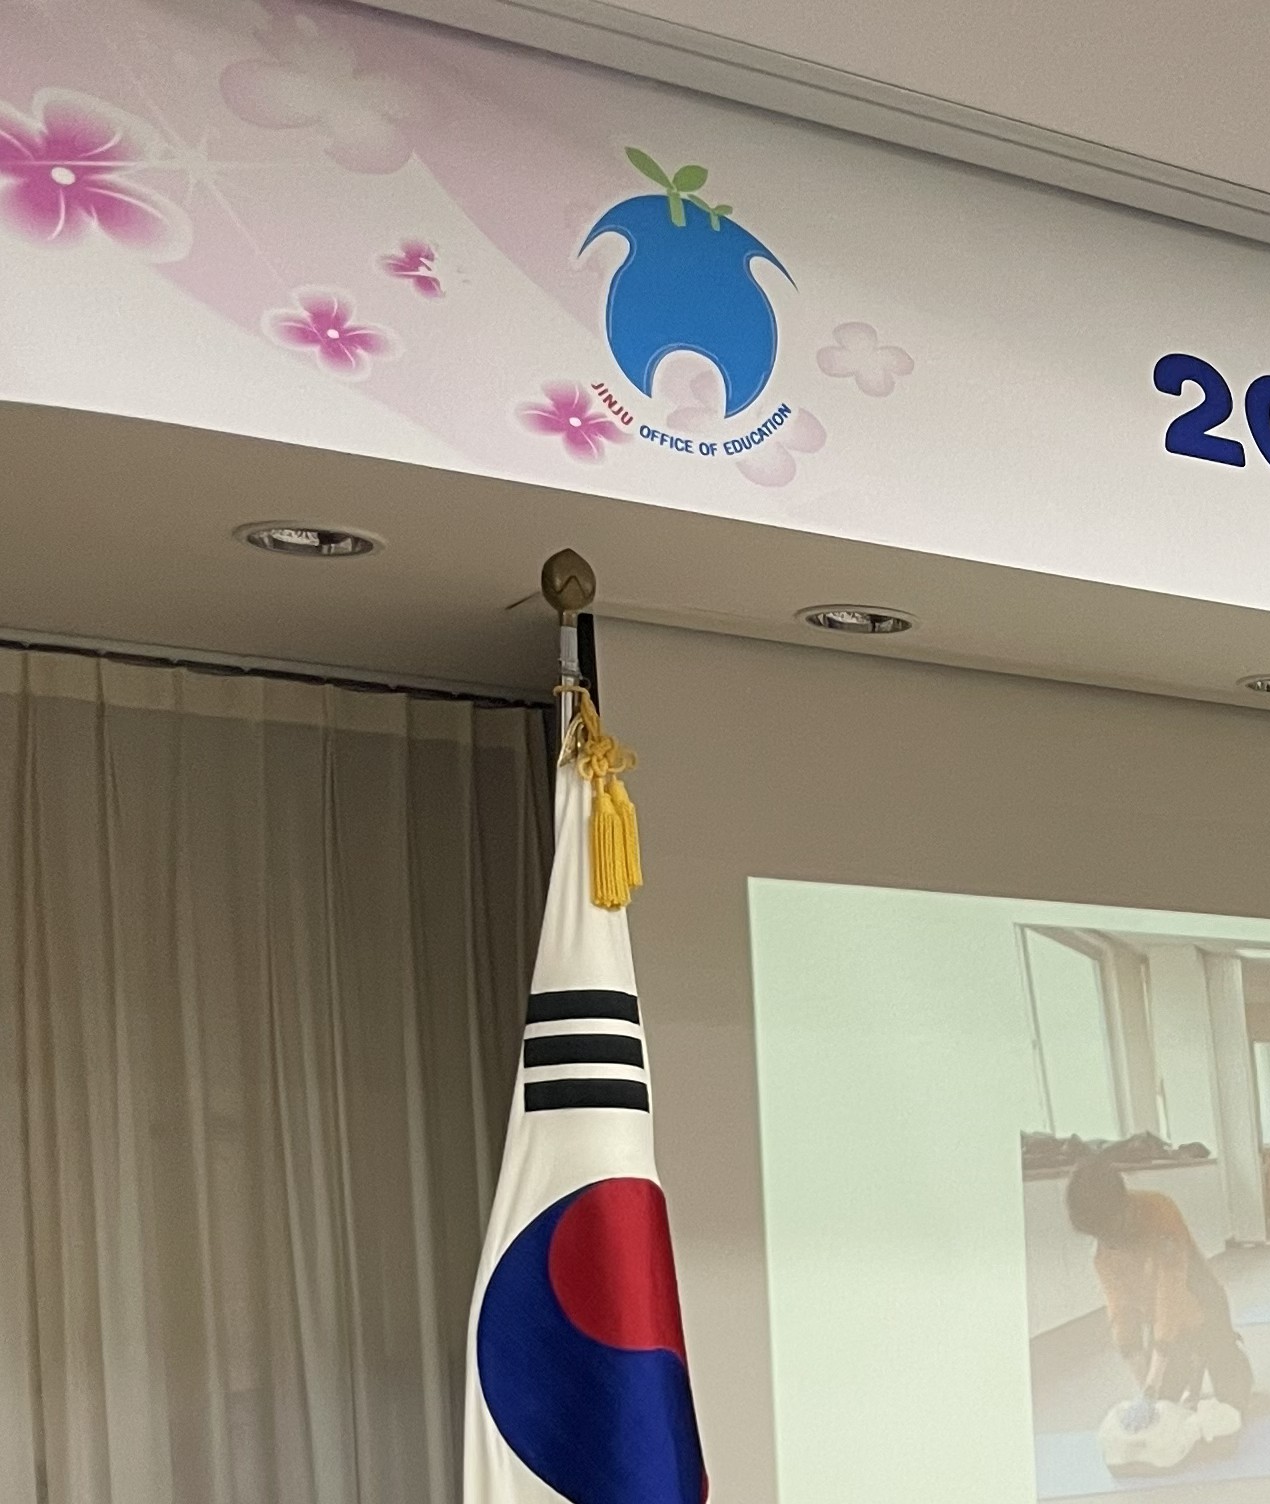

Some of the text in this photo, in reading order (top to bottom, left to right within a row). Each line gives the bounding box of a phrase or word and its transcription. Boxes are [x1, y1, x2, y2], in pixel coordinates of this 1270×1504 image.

[591, 381, 793, 456] JINJU OFFICE OF EDUCATION
